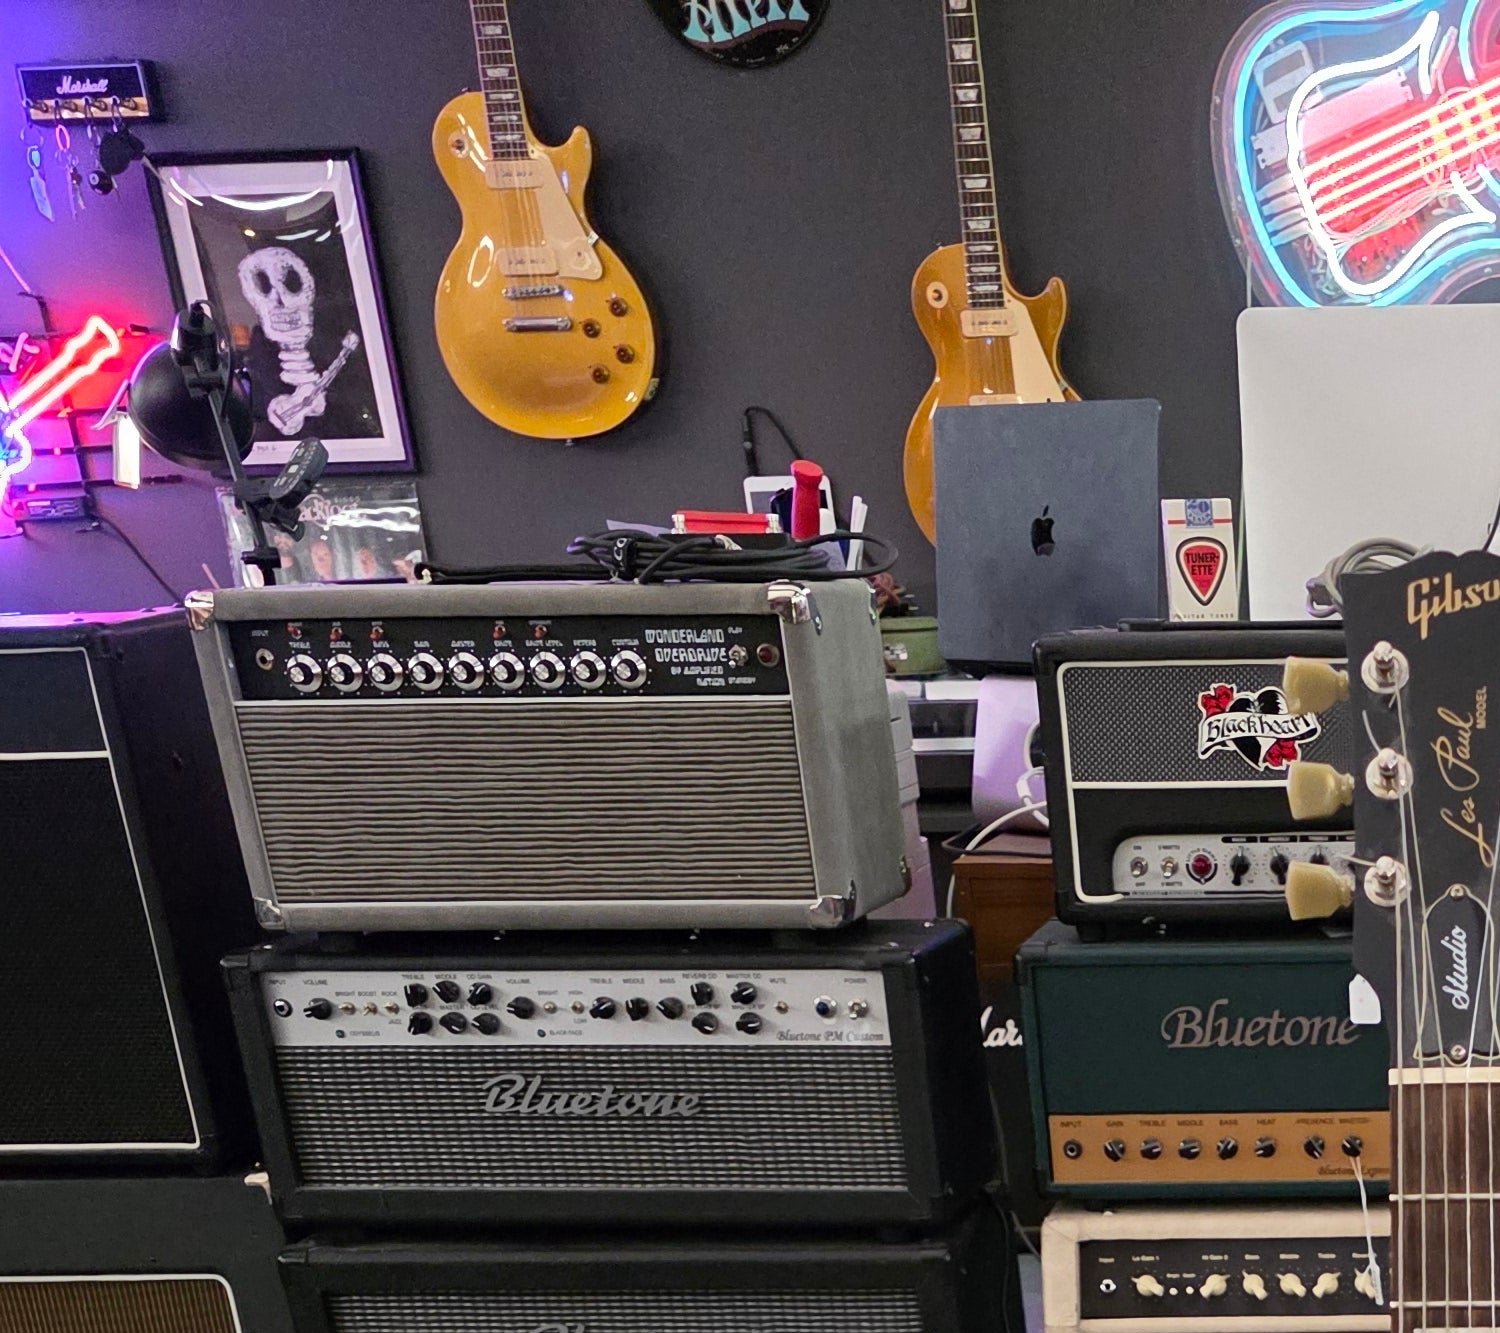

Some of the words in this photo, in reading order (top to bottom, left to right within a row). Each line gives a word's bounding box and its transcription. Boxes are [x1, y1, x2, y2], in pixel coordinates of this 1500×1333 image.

[56, 75, 109, 95] Marshall
[1185, 552, 1220, 564] TUNER-
[1191, 565, 1213, 576] ETTE
[645, 628, 724, 643] WONDERLAND
[655, 647, 728, 663] OVERDRIVE
[1475, 685, 1487, 729] MODEL
[1430, 706, 1480, 792] Paul
[1440, 796, 1495, 868] Les
[1440, 924, 1470, 1010] Studio
[1161, 998, 1362, 1048] Bluetone
[776, 1028, 822, 1041] Bluetone
[482, 1074, 702, 1116] Bluetone
[1060, 1120, 1082, 1129] INPUT
[1105, 1120, 1124, 1128] GAIN
